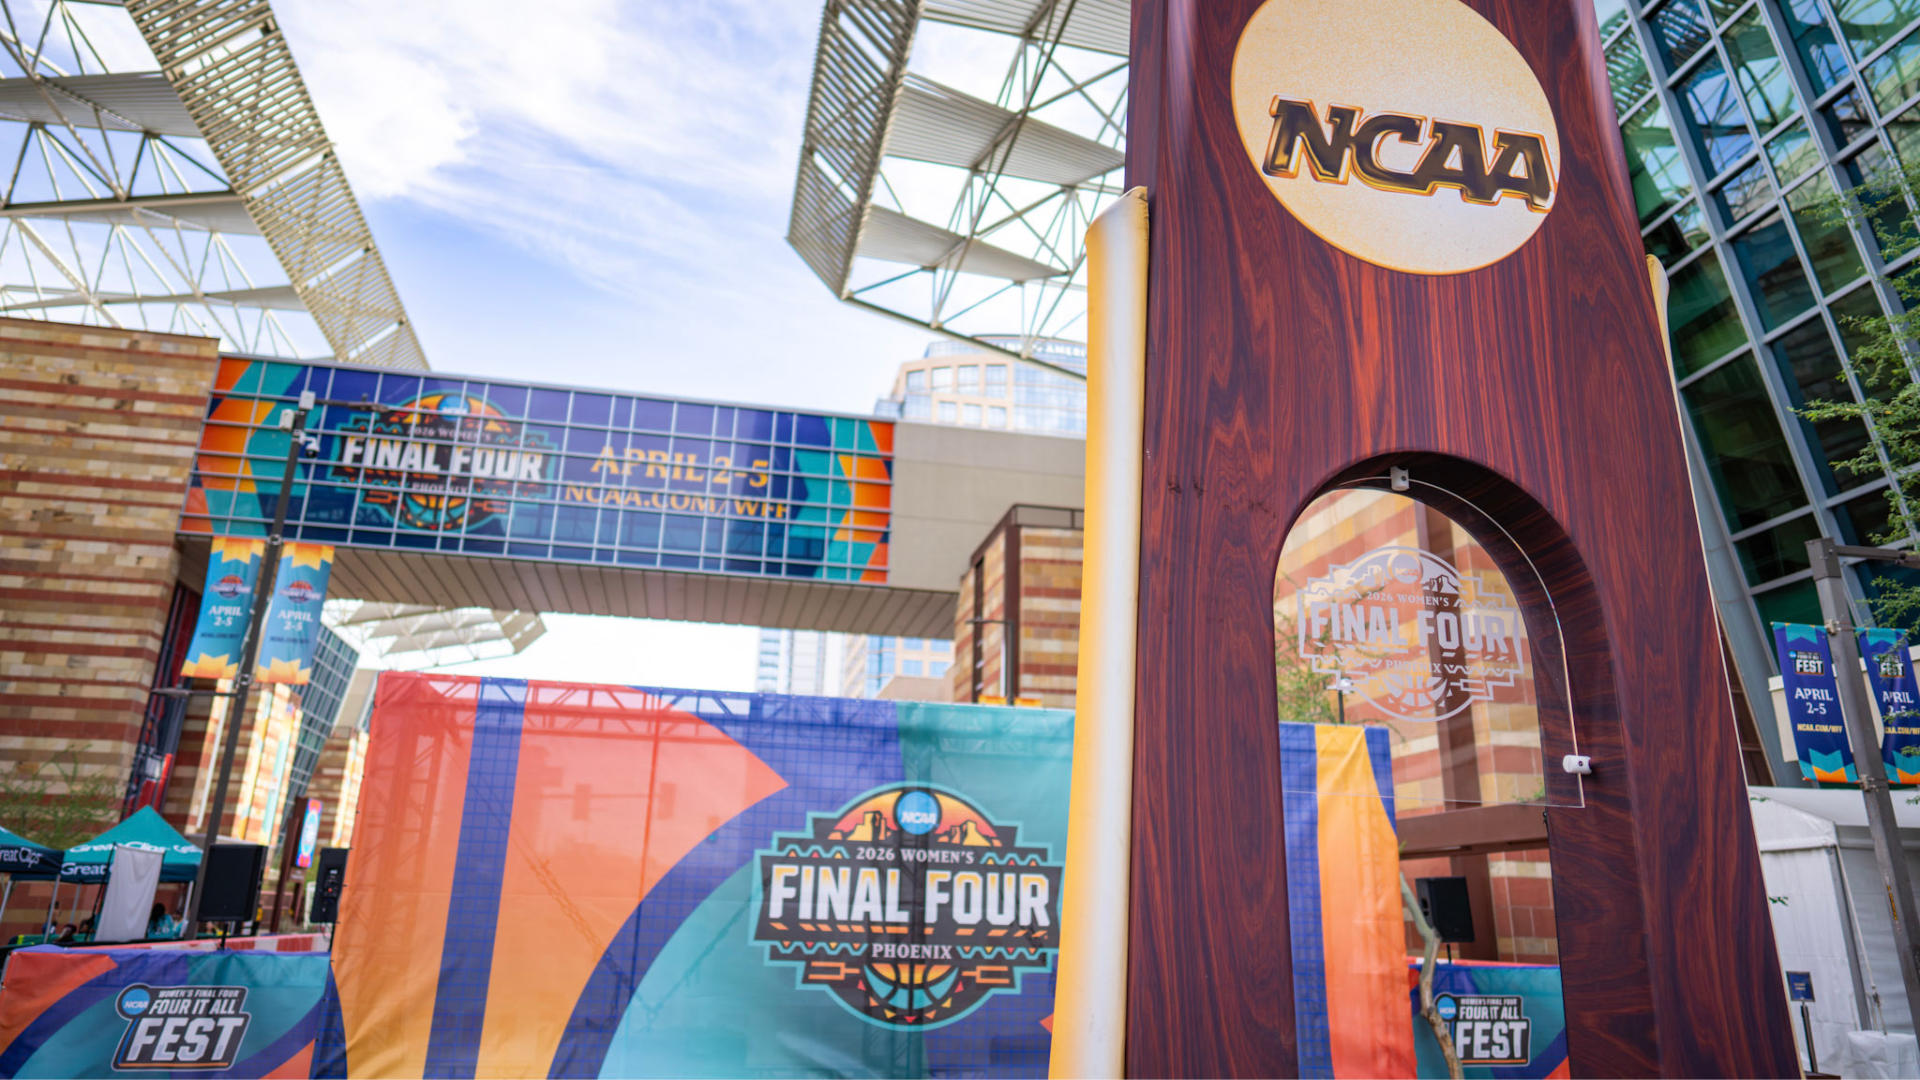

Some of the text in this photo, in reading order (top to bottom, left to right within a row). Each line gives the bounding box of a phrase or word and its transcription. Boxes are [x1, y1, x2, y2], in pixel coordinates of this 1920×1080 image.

[1262, 95, 1557, 214] NCAA
[342, 436, 544, 482] FINAL FOUR
[590, 446, 770, 488] APRIL 2-5
[1366, 590, 1449, 607] 2026 WOMEN'S
[208, 605, 243, 617] APRIL
[277, 609, 314, 623] APRIL
[213, 616, 233, 627] 2-5
[284, 620, 304, 632] 2-5
[1310, 601, 1510, 654] FINAL FOUR
[1385, 659, 1442, 674] PHOENIX
[1796, 659, 1823, 674] FEST
[1794, 687, 1833, 702] APRIL
[1806, 702, 1827, 715] 2-5
[900, 811, 937, 825] NCAA
[855, 847, 975, 864] 2026 WOMEN'S
[60, 862, 107, 876] Great
[768, 864, 1051, 927] FINAL FOUR
[871, 944, 953, 960] PHOENIX
[158, 989, 240, 998] WOMEN'S FINAL FOUR
[123, 1001, 149, 1009] NCAA
[148, 999, 237, 1015] FOUR IT ALL
[1459, 1005, 1519, 1020] FOUR IT ALL
[126, 1017, 245, 1061] FEST
[1456, 1021, 1528, 1059] FEST
